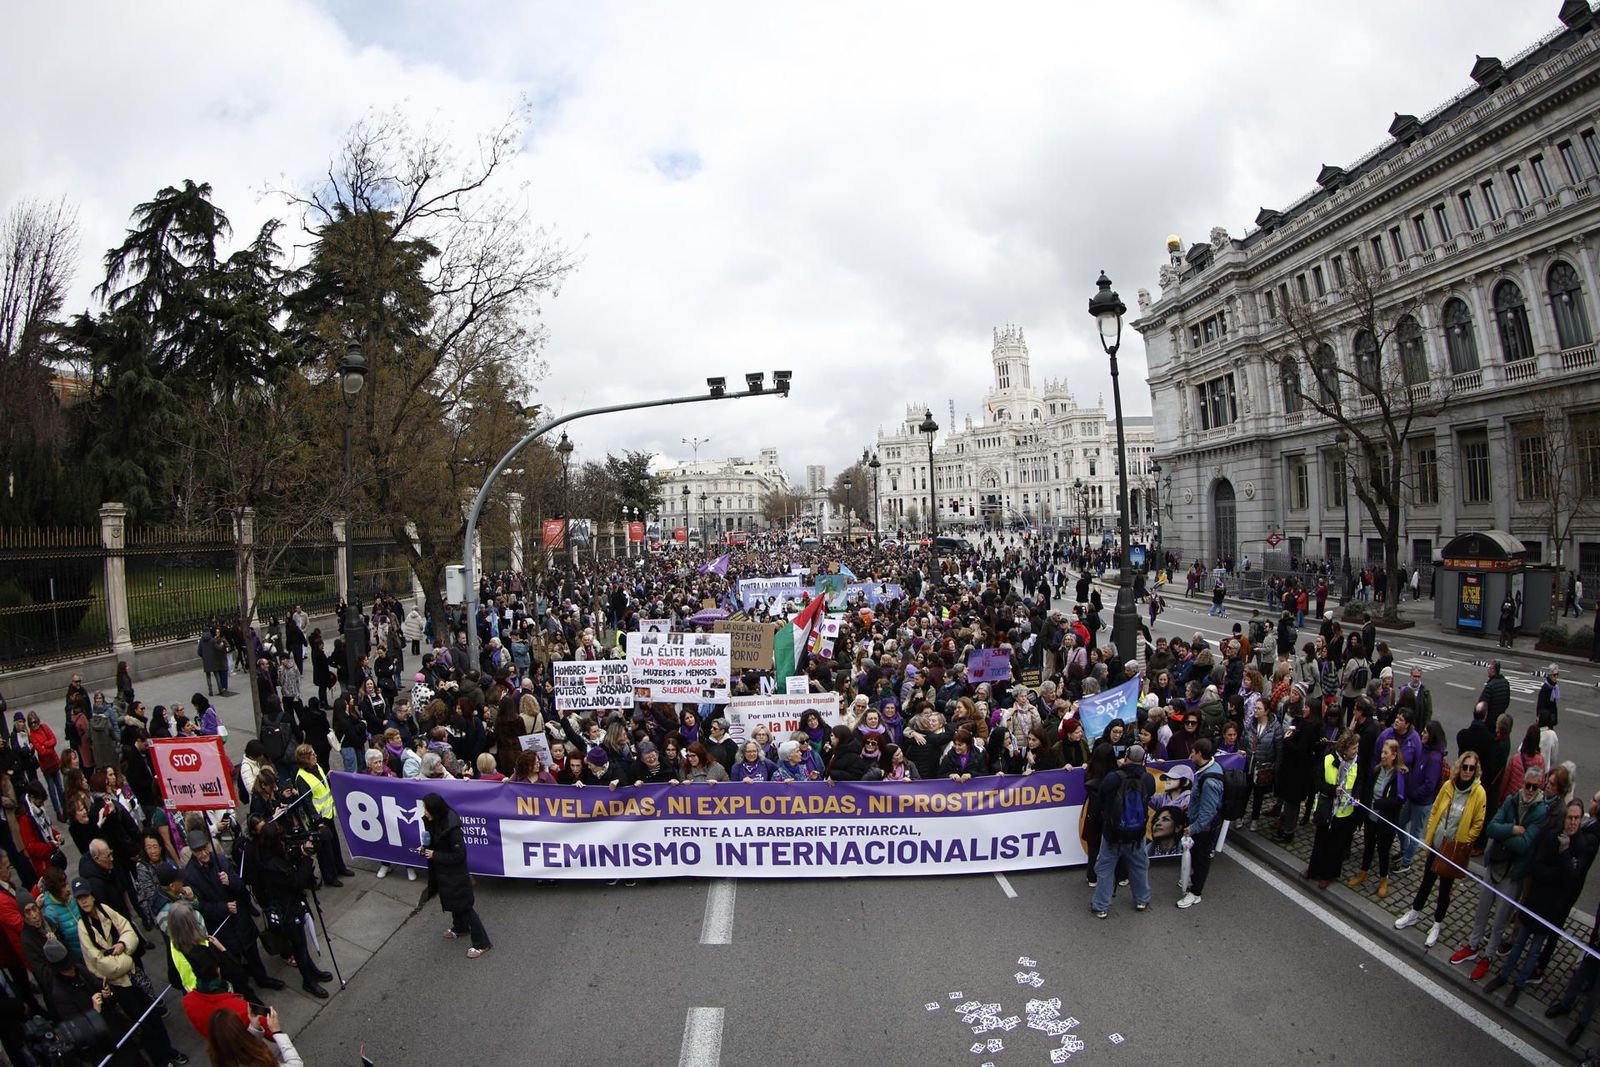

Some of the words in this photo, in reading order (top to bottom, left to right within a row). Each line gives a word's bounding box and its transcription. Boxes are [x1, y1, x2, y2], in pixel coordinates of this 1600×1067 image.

[741, 582, 761, 591] CONTRA
[731, 632, 761, 642] PSTEIN
[641, 646, 653, 656] LA
[632, 658, 654, 666] VIOLA
[657, 658, 686, 666] TORTURA
[688, 658, 717, 666] ASESINA
[554, 665, 586, 675] HOMBRES
[601, 664, 628, 674] MANDO
[685, 668, 717, 676] MENORES
[555, 686, 586, 696] PUTEROS
[596, 684, 632, 695] ACOSANDO
[571, 696, 615, 707] VIOLANDO
[769, 721, 781, 732] la
[785, 720, 800, 732] M
[173, 754, 198, 766] STOP
[167, 778, 196, 798] Trump's
[200, 777, 223, 795] wars!
[517, 796, 540, 816] NI
[545, 797, 661, 818] VELADAS,
[668, 796, 691, 815] NI
[697, 795, 862, 816] EXPLOTADAS,
[868, 795, 892, 814] NI
[898, 783, 1066, 813] PROSTITUIDAS
[346, 791, 426, 847] 8M
[460, 816, 487, 825] IENTO
[462, 826, 487, 836] NISTA
[664, 826, 718, 838] FRENTE
[721, 827, 731, 838] A
[734, 827, 753, 837] LA
[757, 826, 827, 837] BARBARIE
[829, 825, 922, 837] PATRIARCAL,
[463, 837, 489, 845] ADRID
[522, 841, 701, 868] FEMINISMO
[715, 830, 1062, 866] INTERNACIONALISTA
